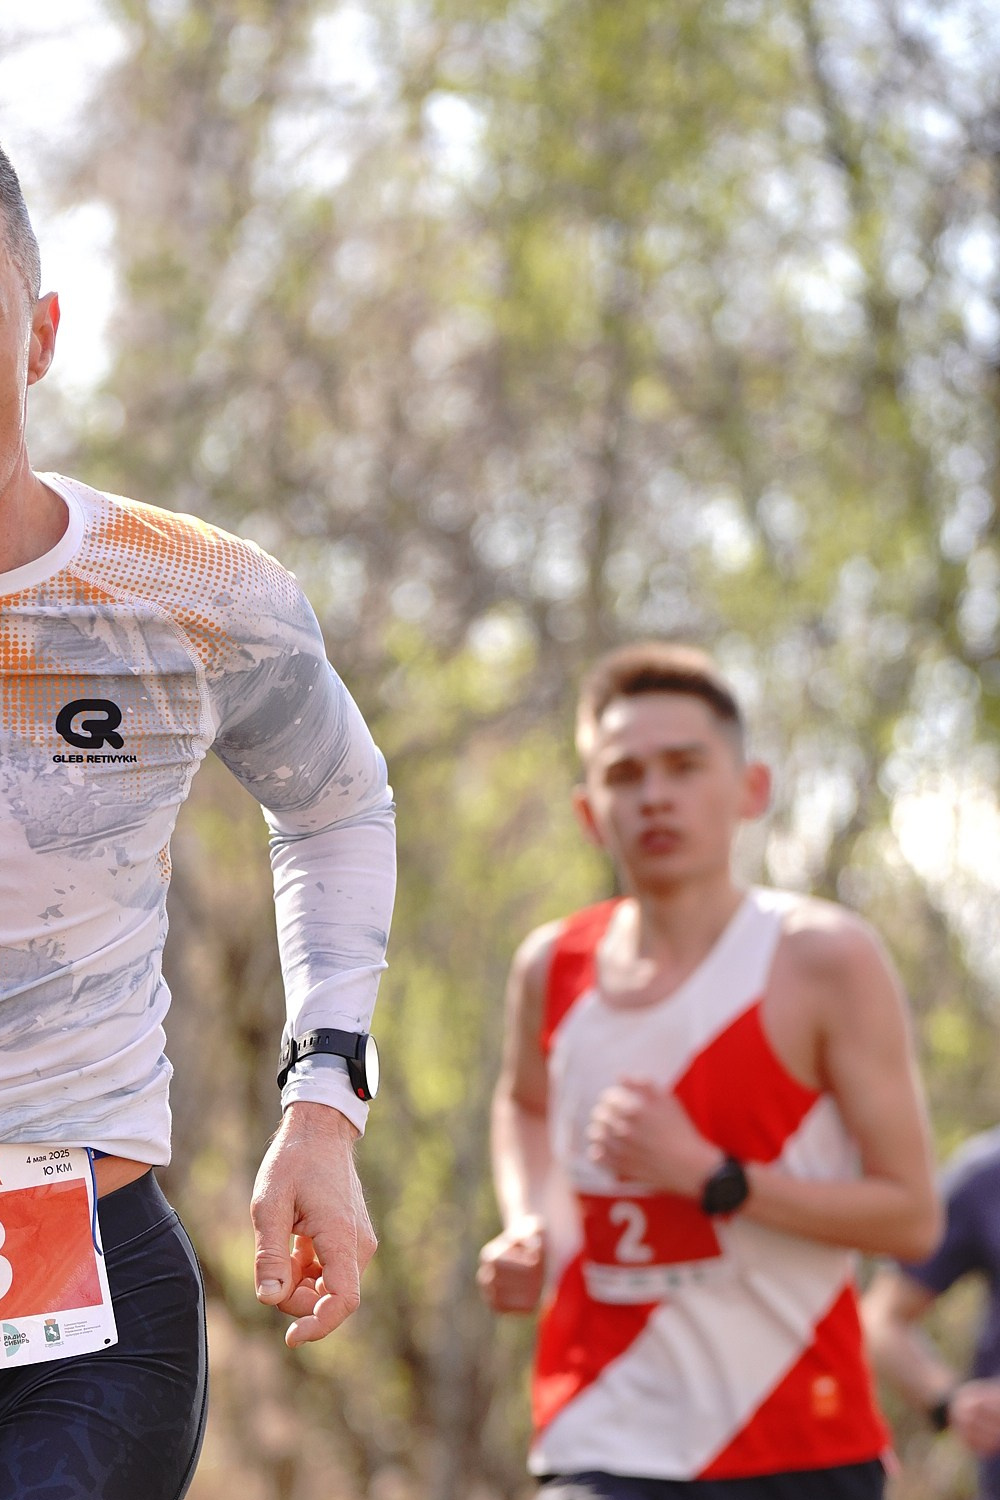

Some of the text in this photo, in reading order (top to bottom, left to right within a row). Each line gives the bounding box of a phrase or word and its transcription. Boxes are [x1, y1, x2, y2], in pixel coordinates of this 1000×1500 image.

[53, 755, 138, 763] GLEB RETIVYKH
[26, 1156, 31, 1164] 4
[49, 1149, 70, 1161] 2025
[43, 1163, 73, 1176] 10 КМ
[609, 1201, 655, 1264] 2
[3, 1333, 27, 1342] РАДИО
[3, 1339, 30, 1347] СИБИРЬ
